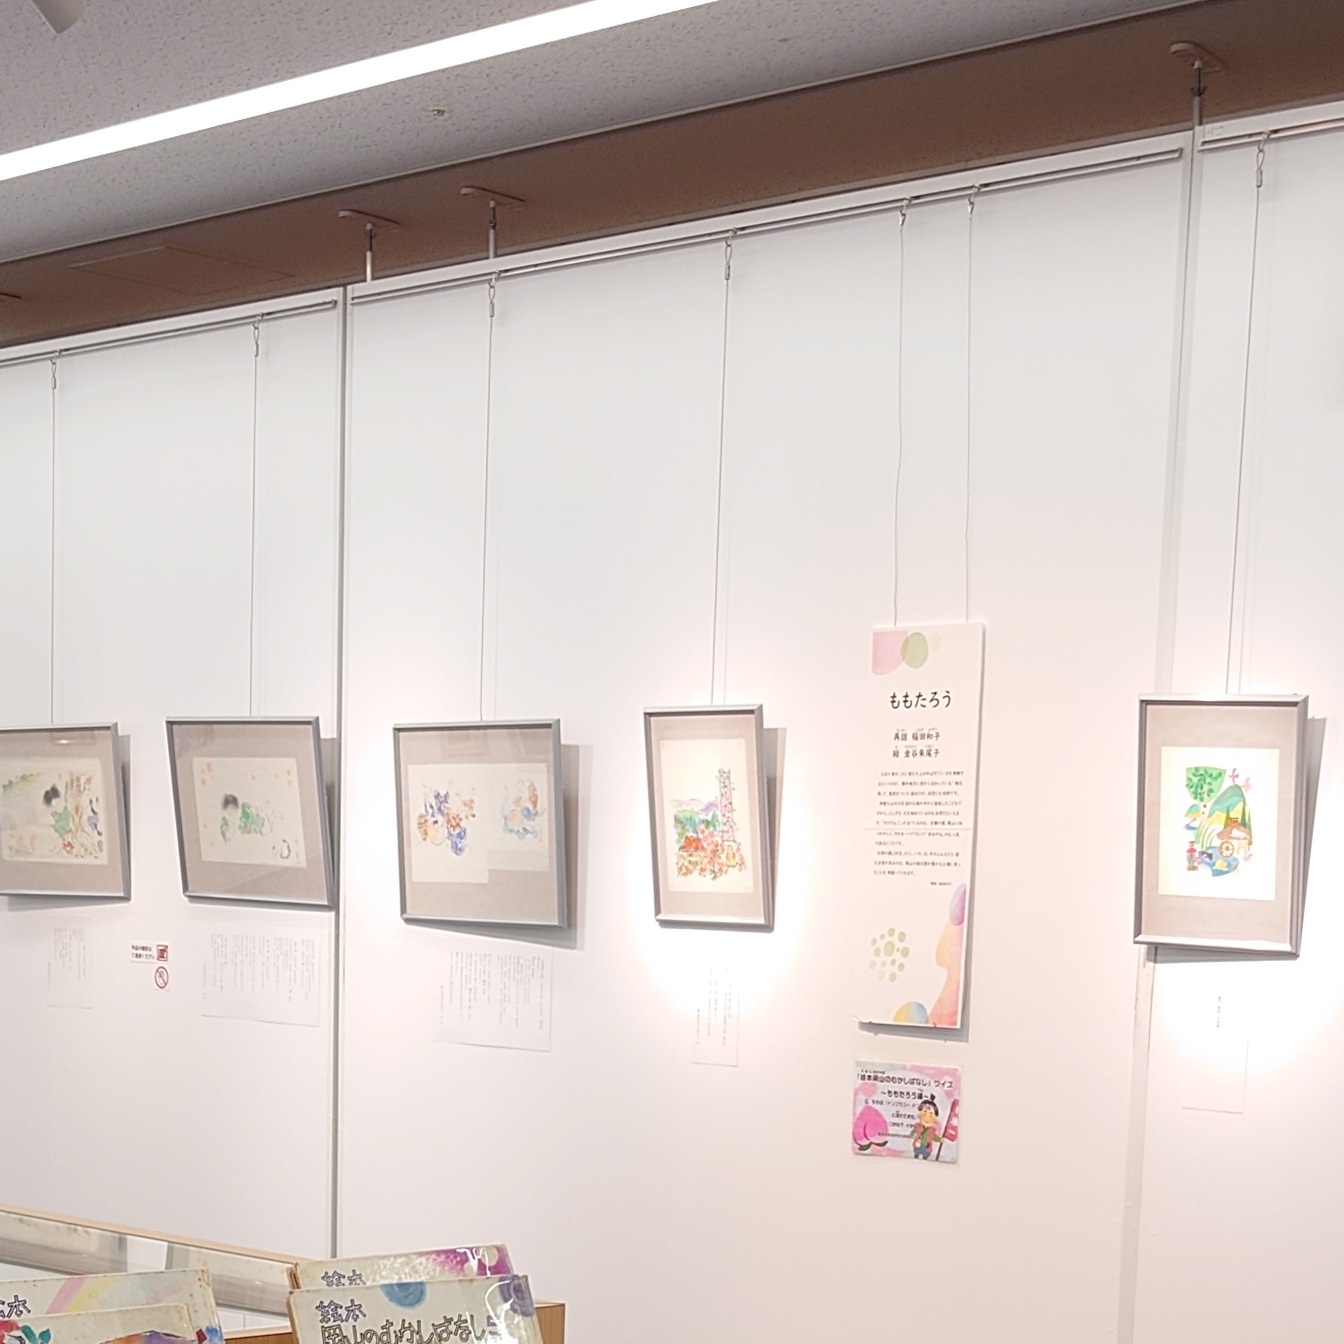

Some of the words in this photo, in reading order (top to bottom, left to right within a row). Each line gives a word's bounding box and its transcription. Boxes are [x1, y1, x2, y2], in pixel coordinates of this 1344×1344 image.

[889, 690, 951, 709] ももたろう
[316, 1299, 367, 1323] 絵本
